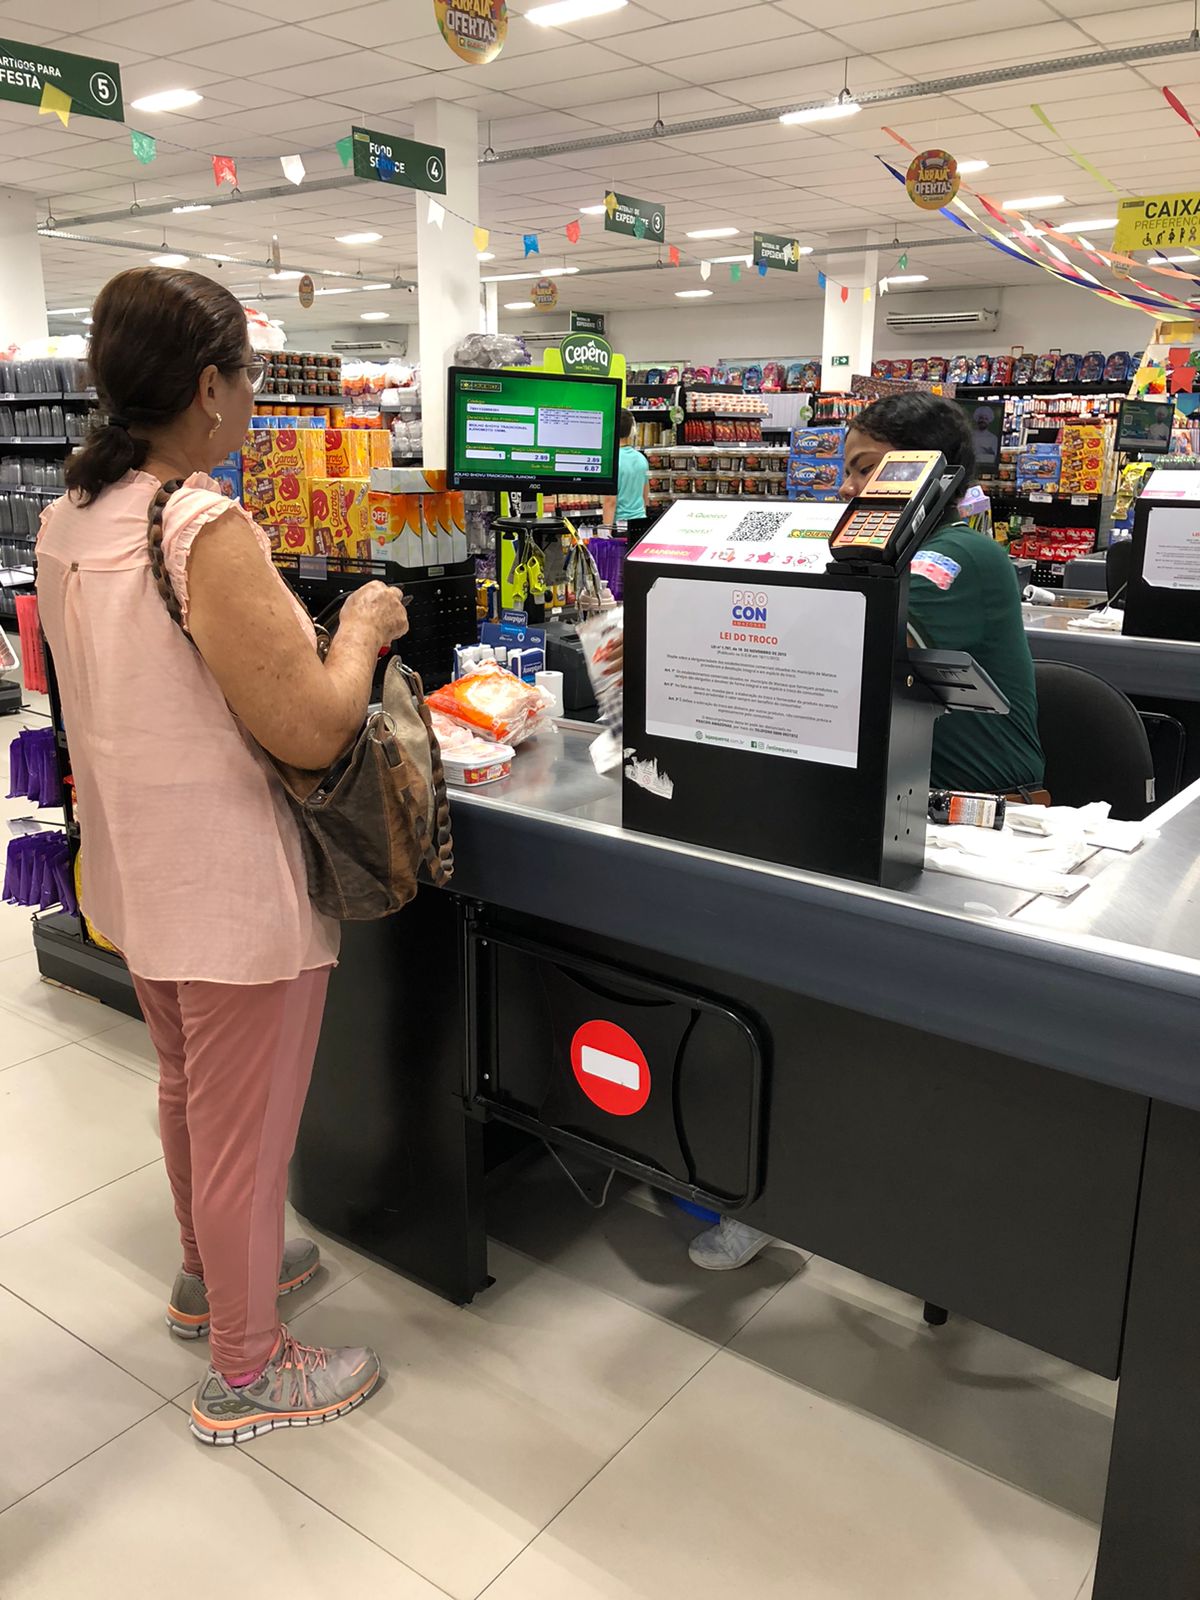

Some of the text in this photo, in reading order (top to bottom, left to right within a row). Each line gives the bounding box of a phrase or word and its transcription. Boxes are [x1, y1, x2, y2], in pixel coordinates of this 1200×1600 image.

[446, 10, 497, 42] OFERTAS
[37, 63, 62, 78] PARA
[0, 68, 41, 90] FESTA
[98, 78, 110, 100] 5
[369, 142, 392, 158] FOOD
[431, 162, 439, 178] 4
[915, 181, 952, 195] OFERTAS
[655, 216, 660, 230] 3
[762, 249, 785, 260] EXPEDIENT
[273, 452, 298, 467] Garoto
[276, 501, 302, 516] Garoto
[372, 512, 388, 524] OFF!
[744, 554, 755, 562] 2
[782, 556, 794, 564] 3
[732, 590, 768, 608] PRO
[732, 606, 767, 622] CON
[720, 632, 778, 645] LEI DO TROCO
